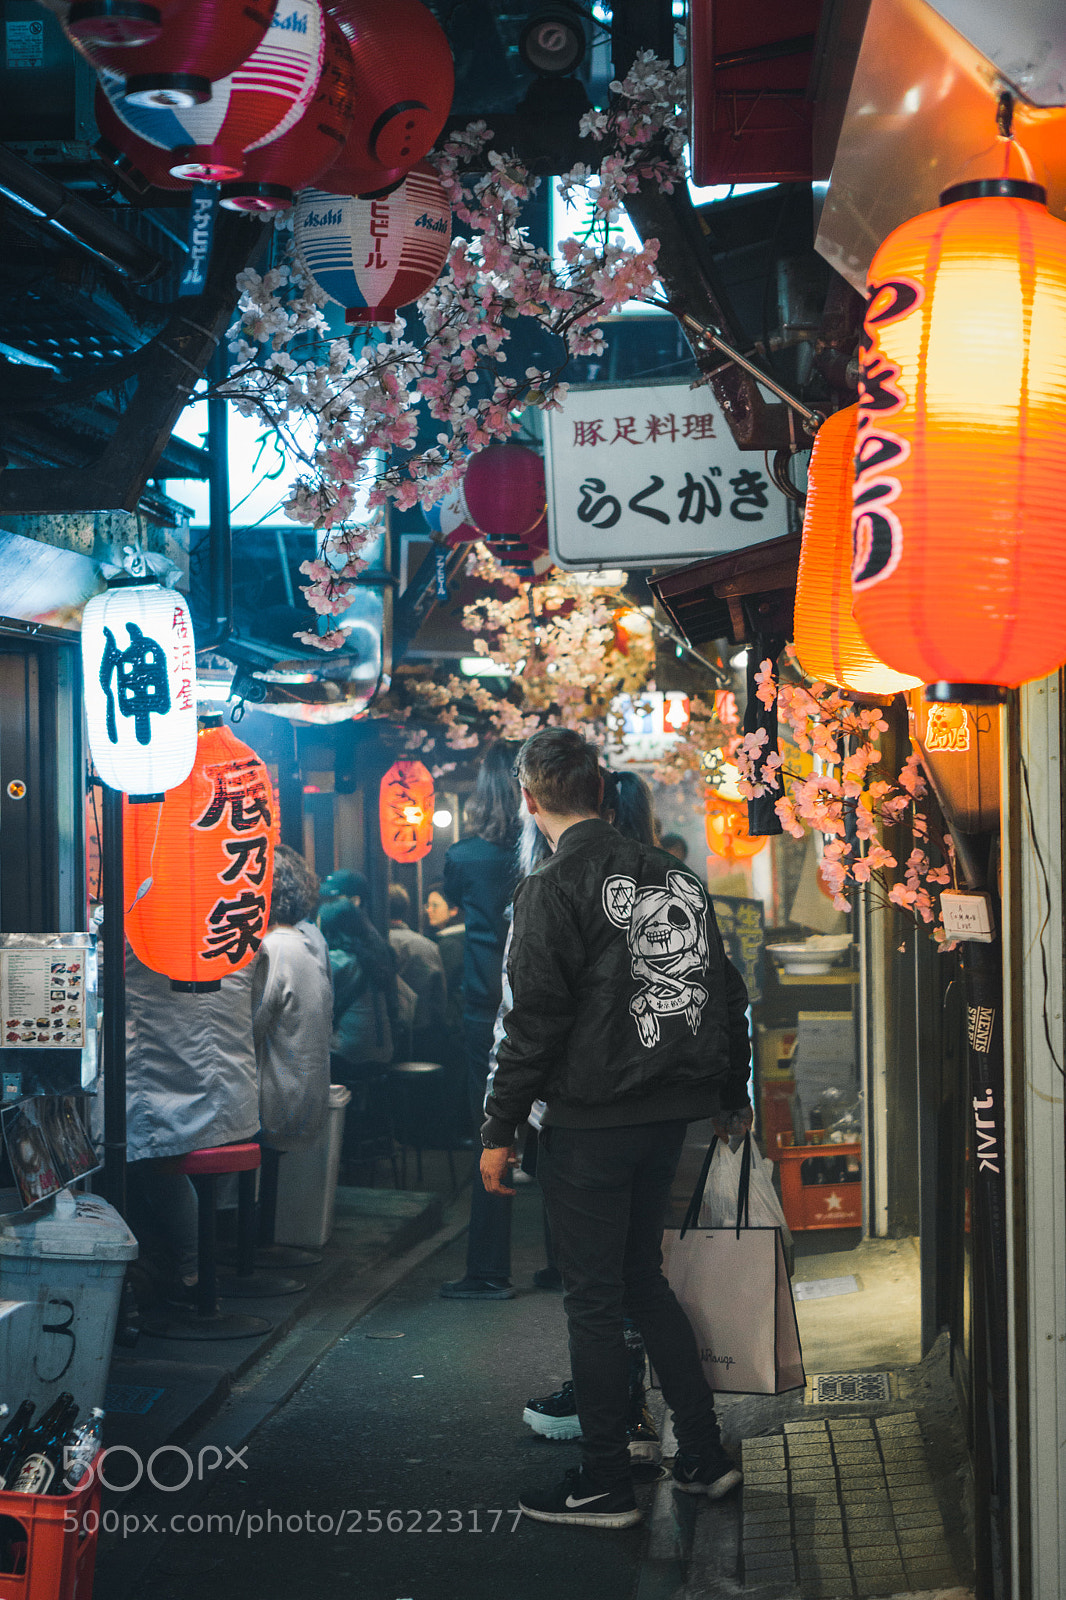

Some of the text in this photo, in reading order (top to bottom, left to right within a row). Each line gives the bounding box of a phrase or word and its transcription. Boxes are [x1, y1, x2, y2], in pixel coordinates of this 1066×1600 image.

[271, 10, 308, 34] sahi
[304, 208, 342, 228] Asahi
[414, 213, 448, 234] Asahi
[364, 197, 390, 269] ヒビール
[573, 413, 717, 447] 豚足料理
[577, 466, 769, 529] らくがき
